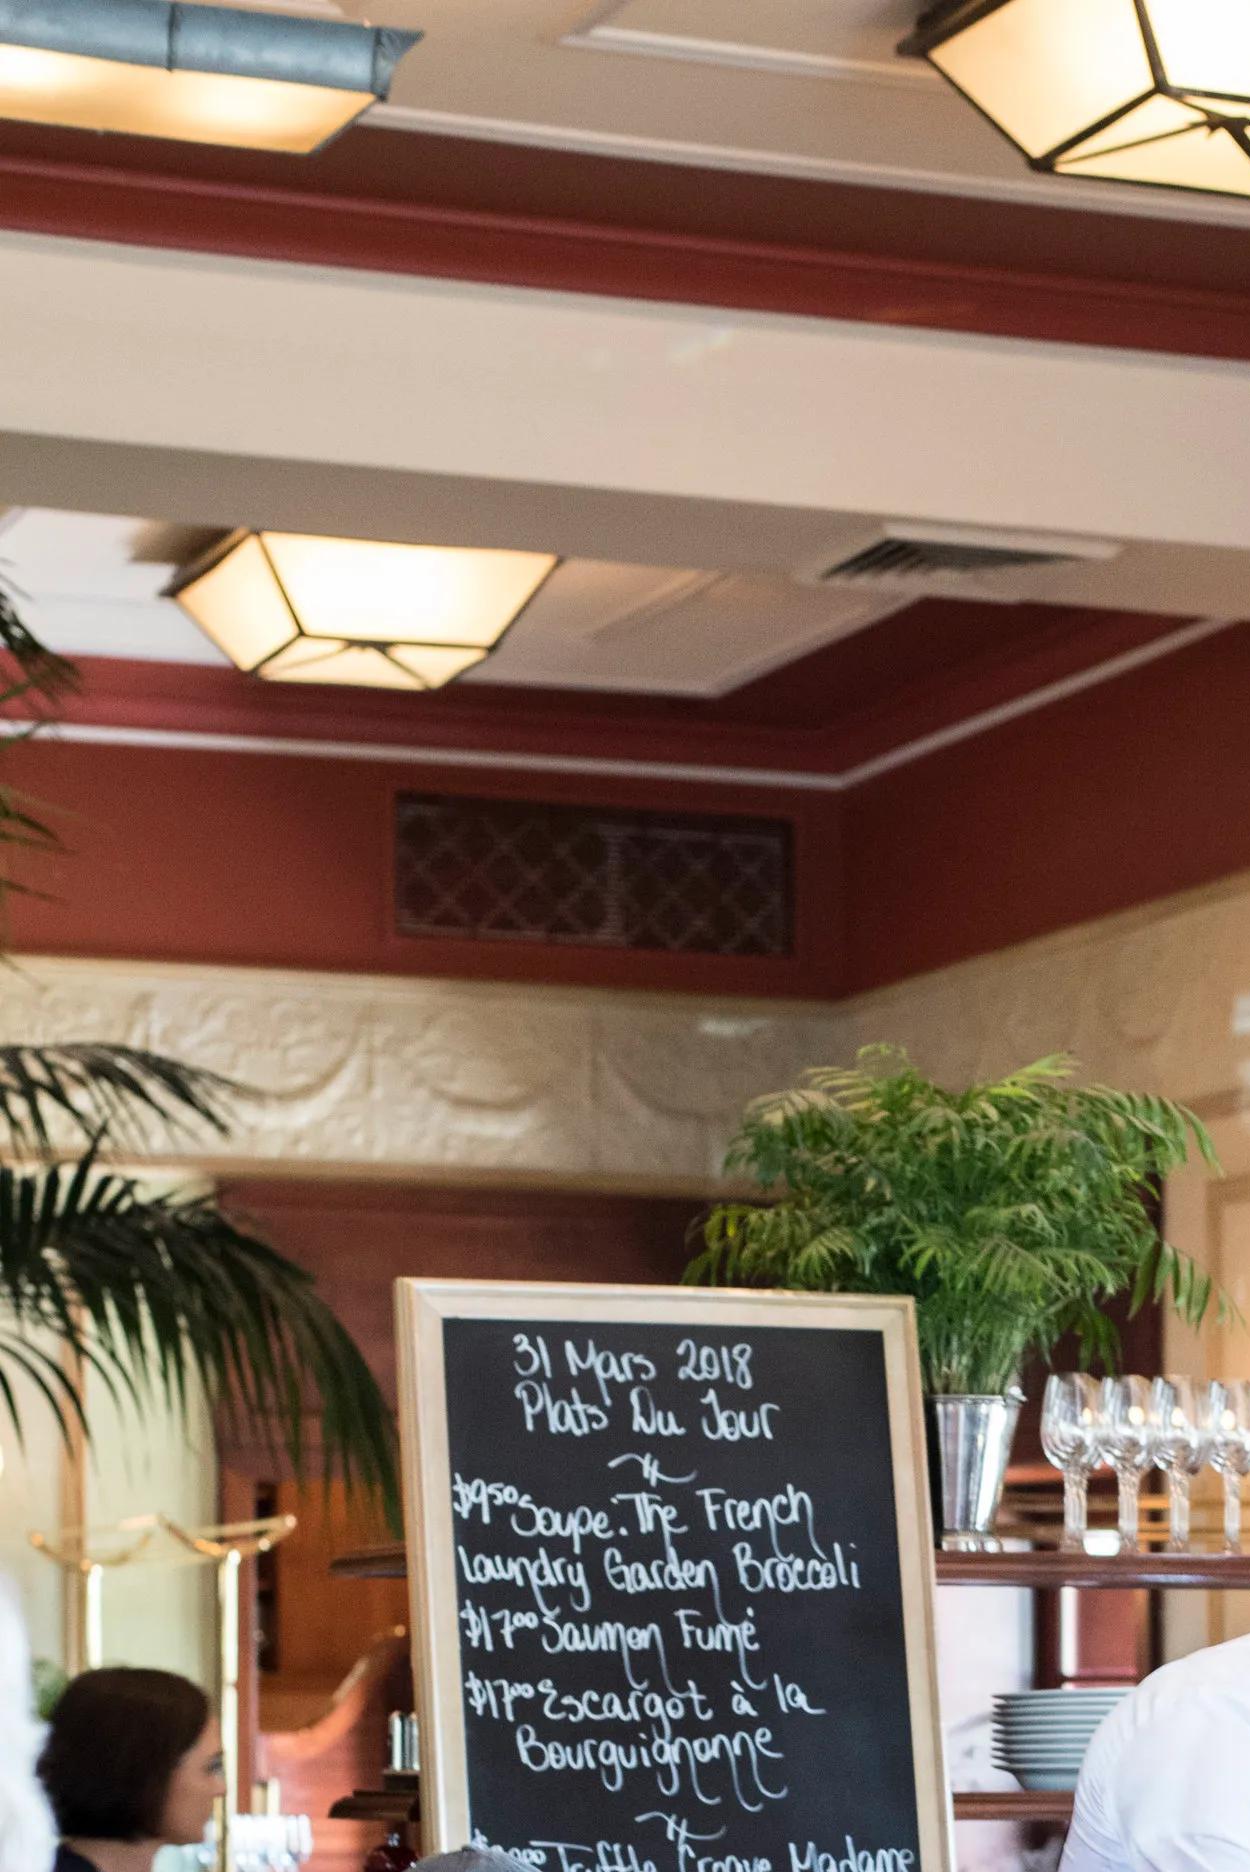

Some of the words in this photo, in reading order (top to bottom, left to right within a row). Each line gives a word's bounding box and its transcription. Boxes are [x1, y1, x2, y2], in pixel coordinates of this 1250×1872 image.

[513, 1333, 552, 1379] 31
[564, 1339, 656, 1406] Mars
[676, 1338, 754, 1390] 2018
[514, 1380, 609, 1437] Plats
[629, 1385, 686, 1437] Du
[700, 1388, 780, 1442] Jour
[615, 1491, 688, 1552] The
[695, 1484, 824, 1556] French
[604, 1547, 733, 1618] Garden
[732, 1541, 861, 1593] Broccoli
[536, 1678, 713, 1738] Escargot
[773, 1673, 827, 1716] la
